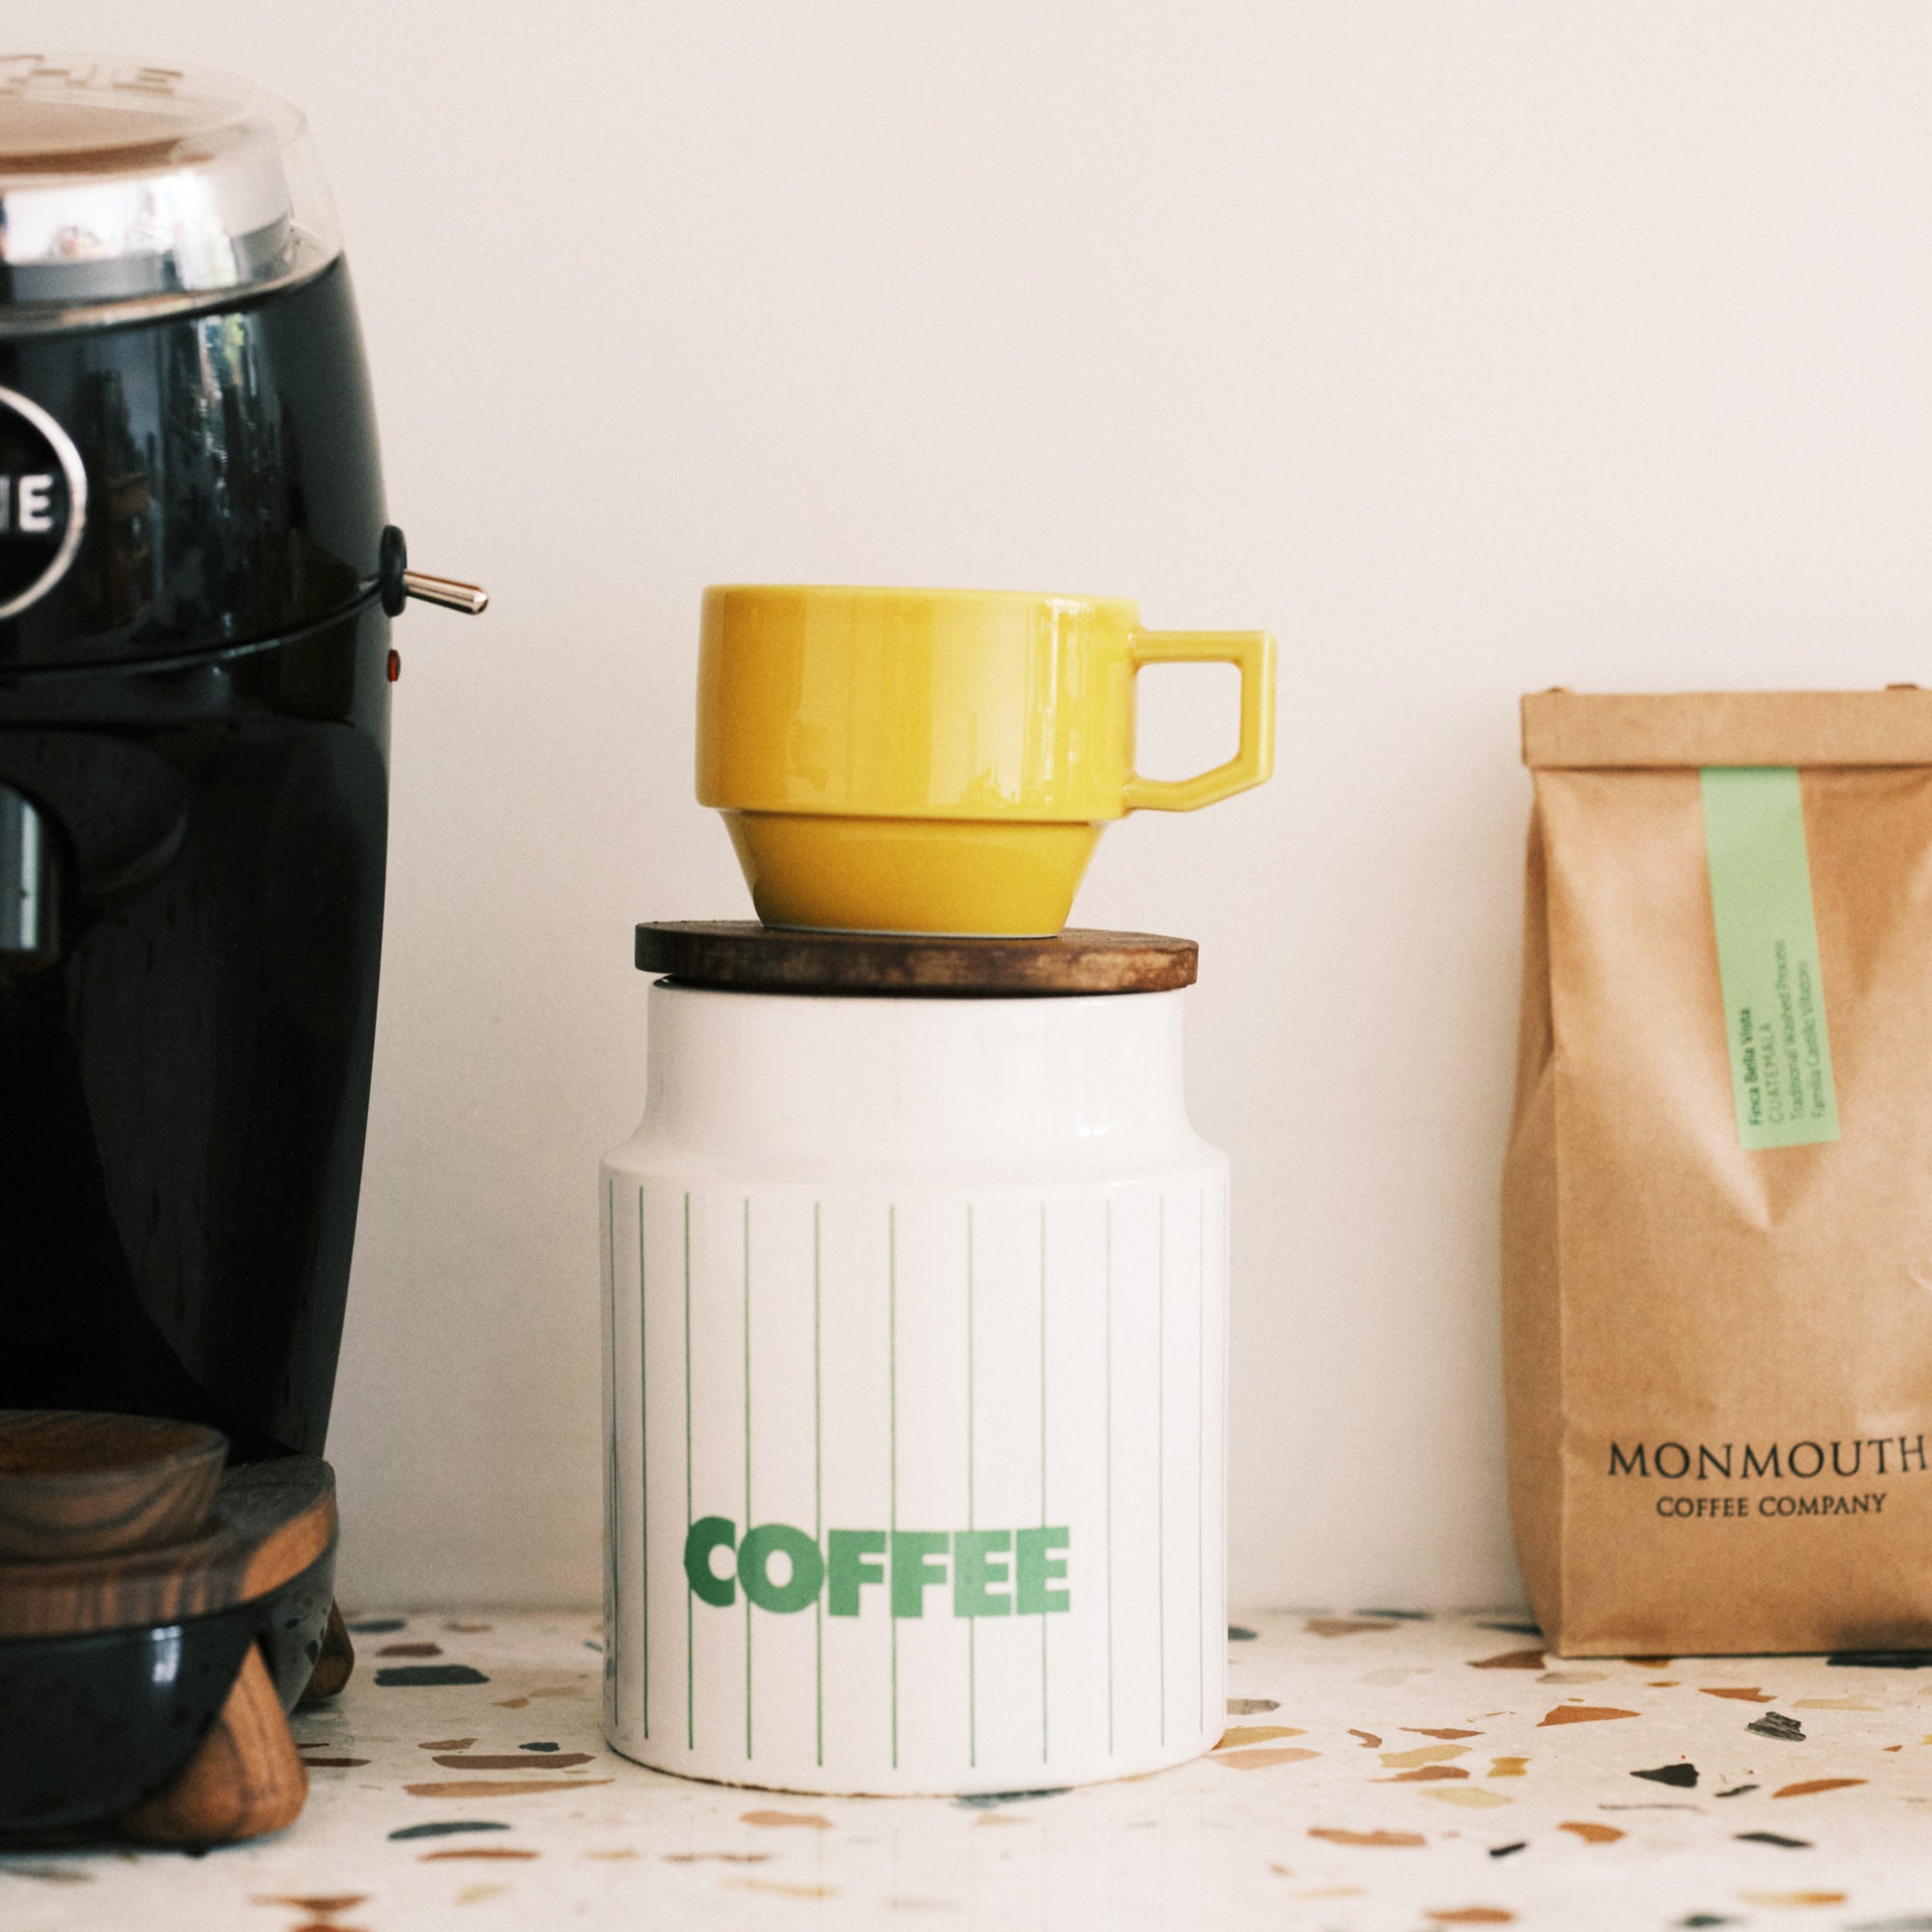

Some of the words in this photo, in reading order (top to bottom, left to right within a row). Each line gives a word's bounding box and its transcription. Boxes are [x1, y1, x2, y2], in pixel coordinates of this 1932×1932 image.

[1774, 939, 1788, 989] Process
[1740, 1007, 1753, 1045] Vista
[1779, 991, 1796, 1044] Washed
[1743, 1047, 1758, 1084] Bella
[1759, 1022, 1784, 1124] GUATEMALA
[1788, 1048, 1804, 1121] Traditional
[1747, 1086, 1762, 1126] Finca
[1809, 1069, 1826, 1119] Familia
[1607, 1434, 1928, 1480] MONMOUTH
[1656, 1496, 1748, 1518] COFFEE
[1758, 1493, 1887, 1517] COMPANY
[684, 1516, 1070, 1618] COFFEE
